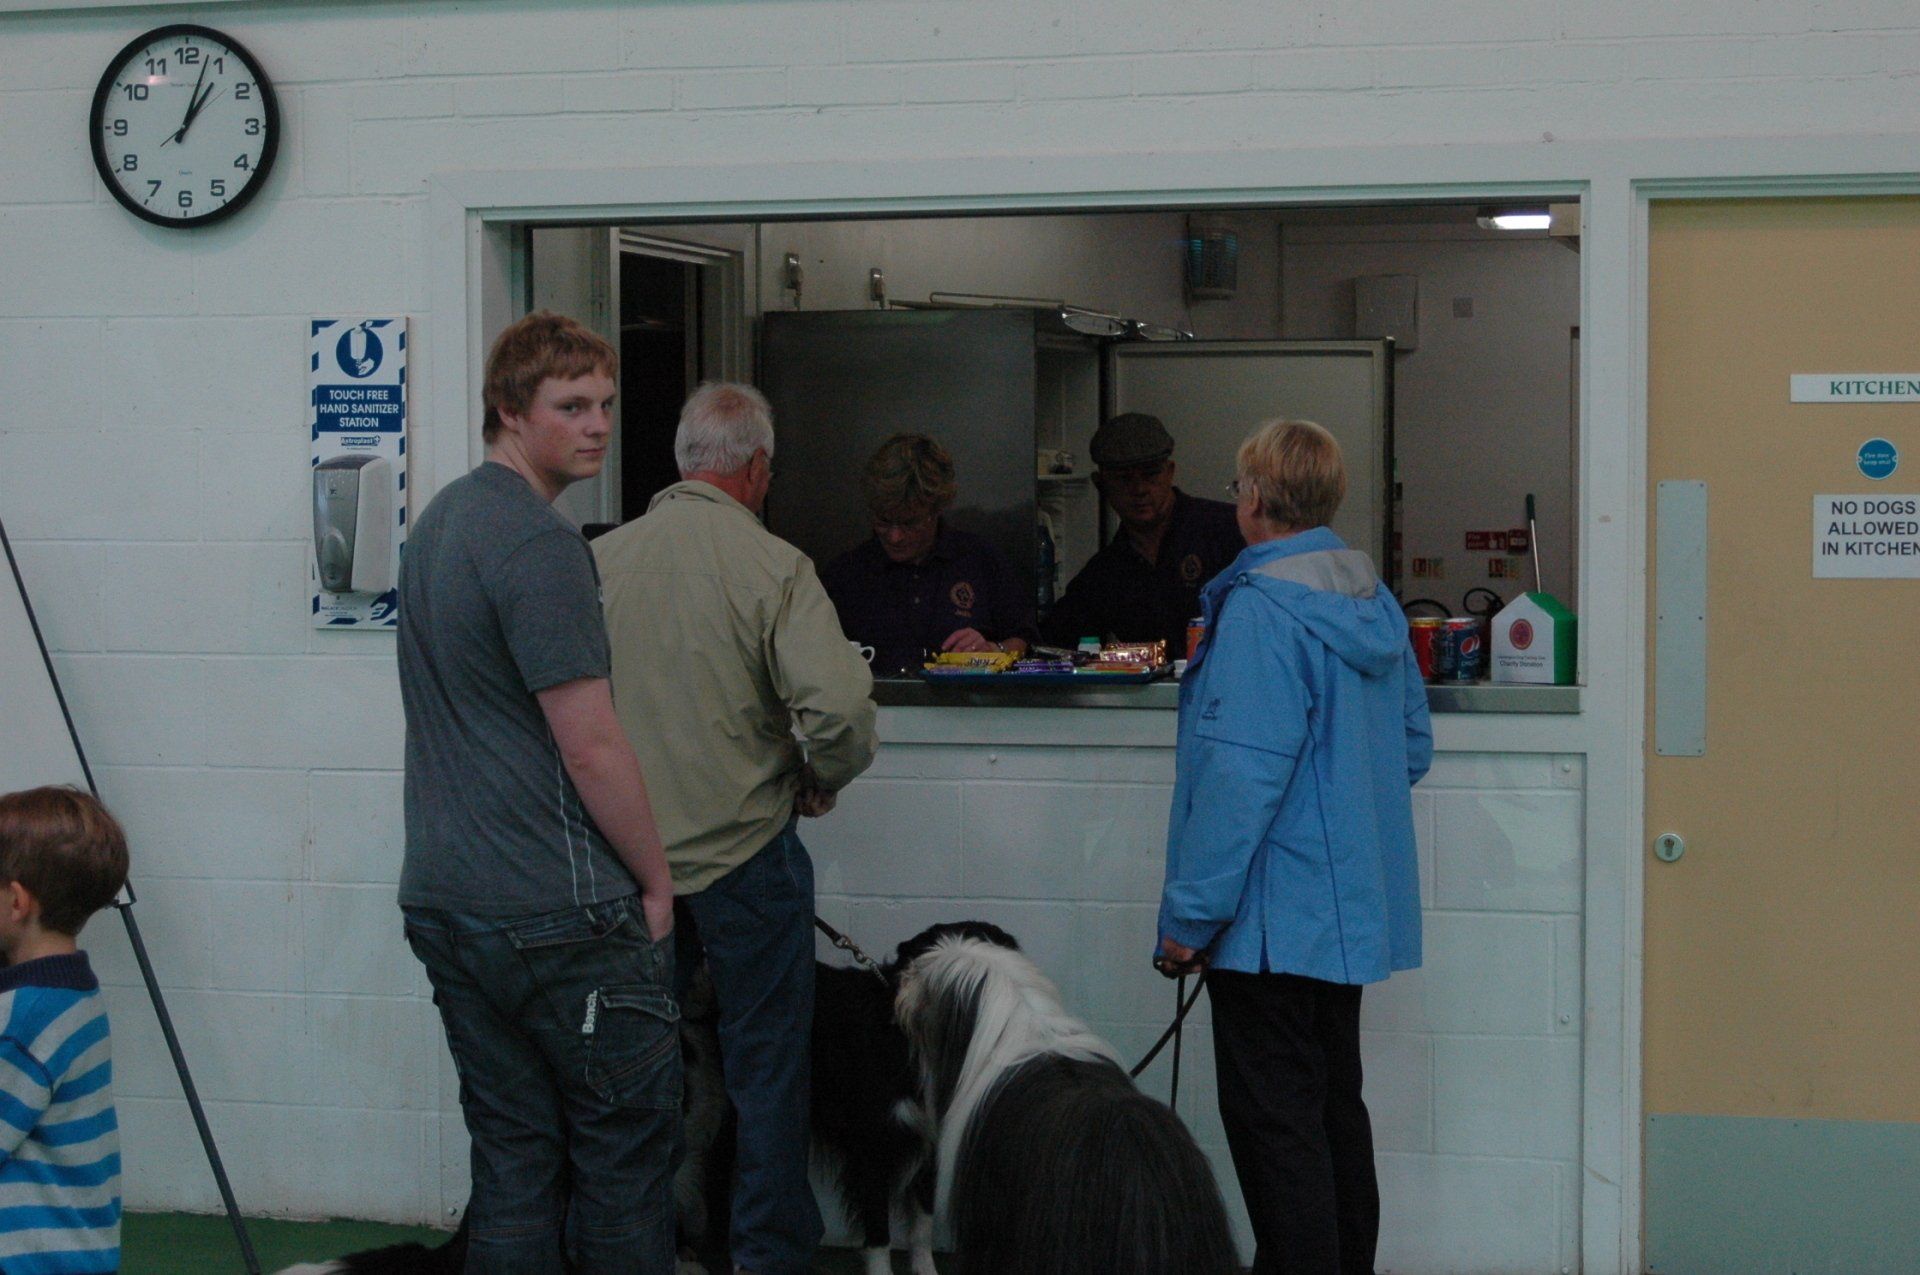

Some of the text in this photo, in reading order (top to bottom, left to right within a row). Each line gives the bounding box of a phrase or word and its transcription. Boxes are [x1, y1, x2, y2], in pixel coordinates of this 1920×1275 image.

[174, 47, 200, 65] 12
[145, 58, 167, 75] 11
[213, 57, 223, 75] 1
[123, 83, 149, 101] 10
[235, 82, 250, 100] 2
[113, 119, 128, 136] 9
[244, 118, 260, 136] 3
[123, 154, 138, 171] 8
[233, 153, 249, 171] 4
[147, 179, 162, 197] 7
[210, 179, 225, 197] 5
[178, 190, 193, 208] 6
[329, 389, 389, 400] TOUCH FREE
[1830, 380, 1920, 396] KITCHEN
[320, 403, 399, 414] HAND SANITIZER
[339, 417, 379, 428] STATION
[1831, 501, 1916, 515] NO DOGS
[1828, 521, 1919, 536] ALLOWED
[1822, 541, 1920, 556] IN KITCHEN
